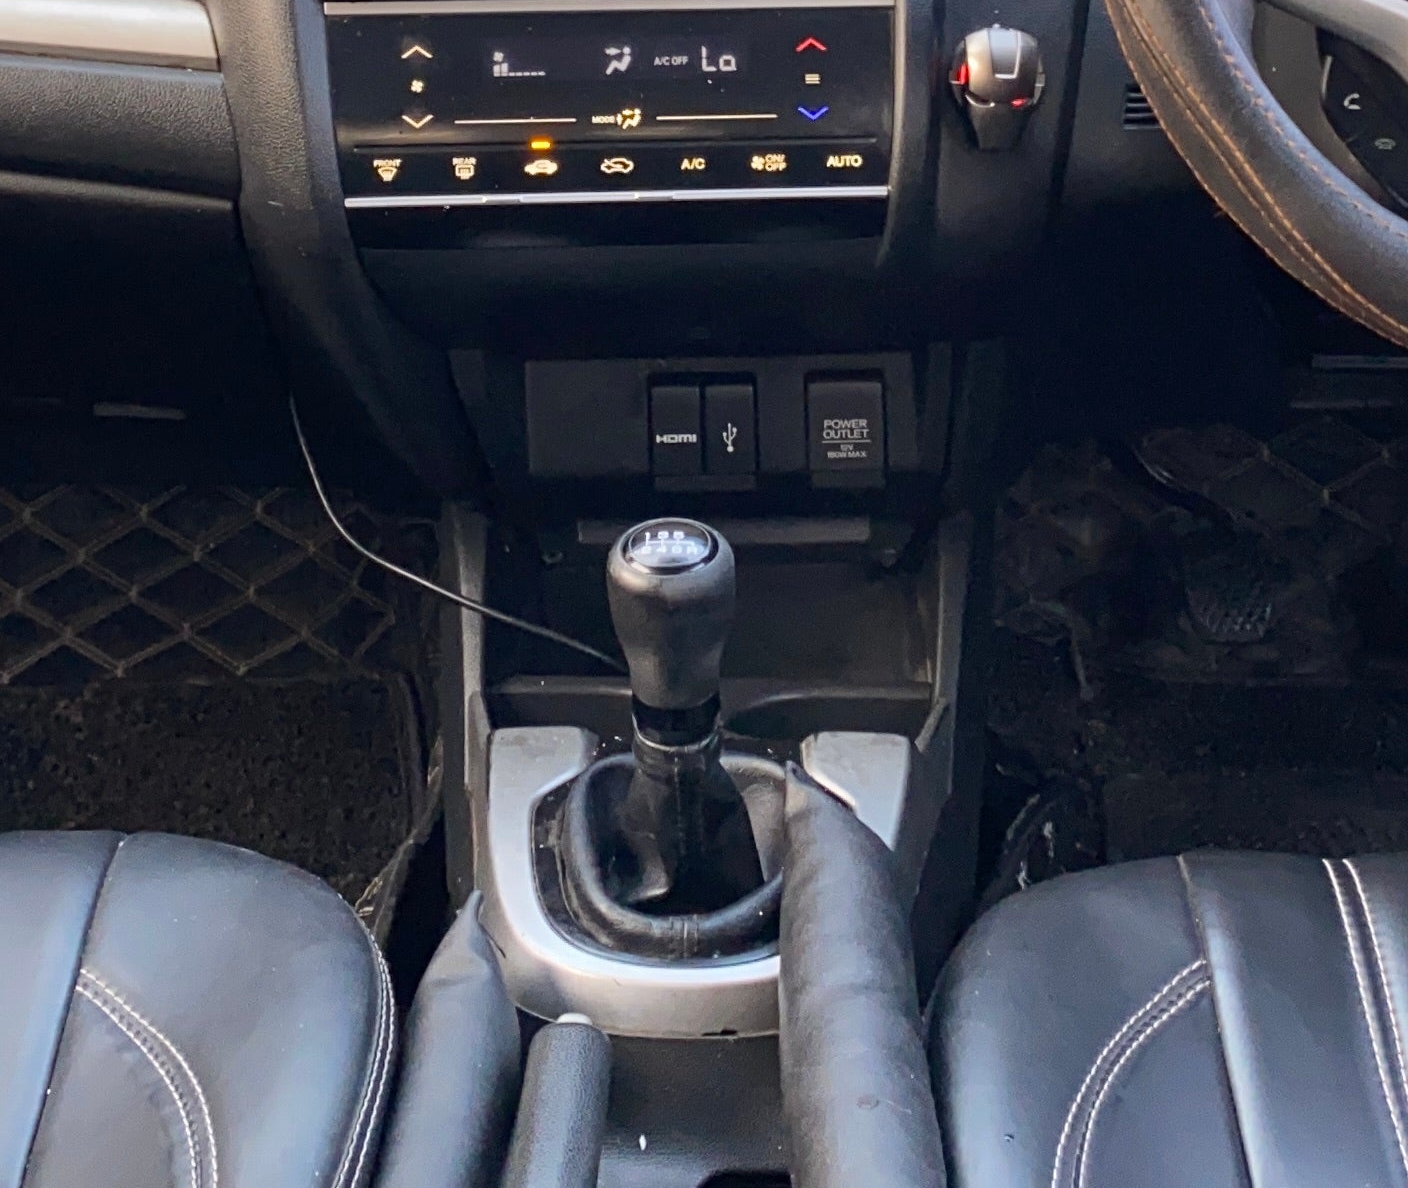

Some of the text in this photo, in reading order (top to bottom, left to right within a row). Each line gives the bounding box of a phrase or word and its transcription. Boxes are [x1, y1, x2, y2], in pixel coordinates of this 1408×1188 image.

[654, 55, 689, 66] A/C OFF
[680, 157, 706, 171] A/C
[826, 154, 863, 168] AUTO
[765, 162, 787, 172] OFF
[823, 418, 868, 429] POWER
[823, 428, 870, 439] OUTLET
